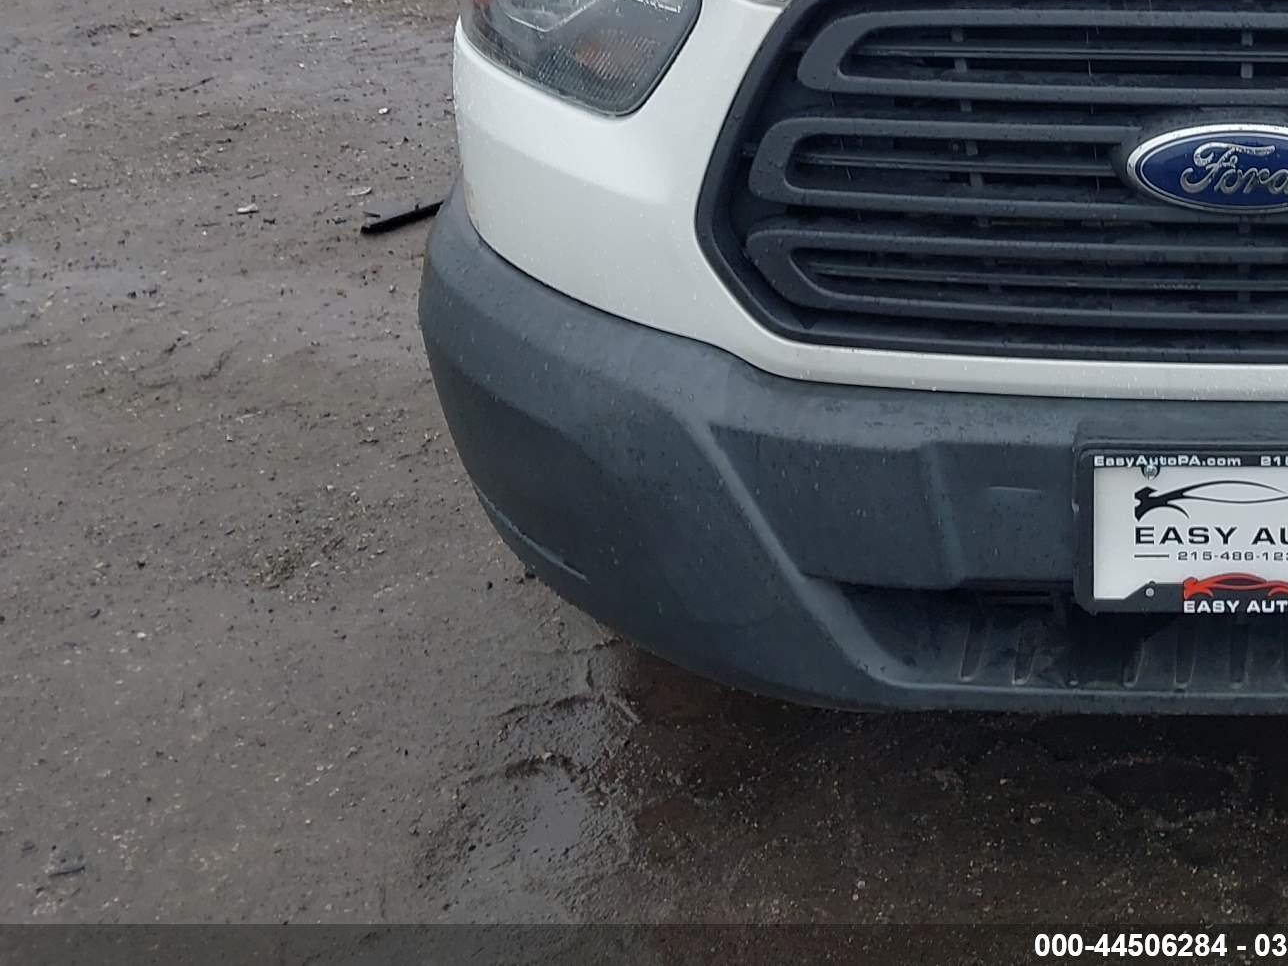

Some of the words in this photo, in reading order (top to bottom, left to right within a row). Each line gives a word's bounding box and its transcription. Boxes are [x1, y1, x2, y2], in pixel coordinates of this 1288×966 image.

[1094, 455, 1242, 467] EasyAutoPA.com
[1135, 526, 1238, 546] EASY
[1183, 600, 1240, 613] EASY
